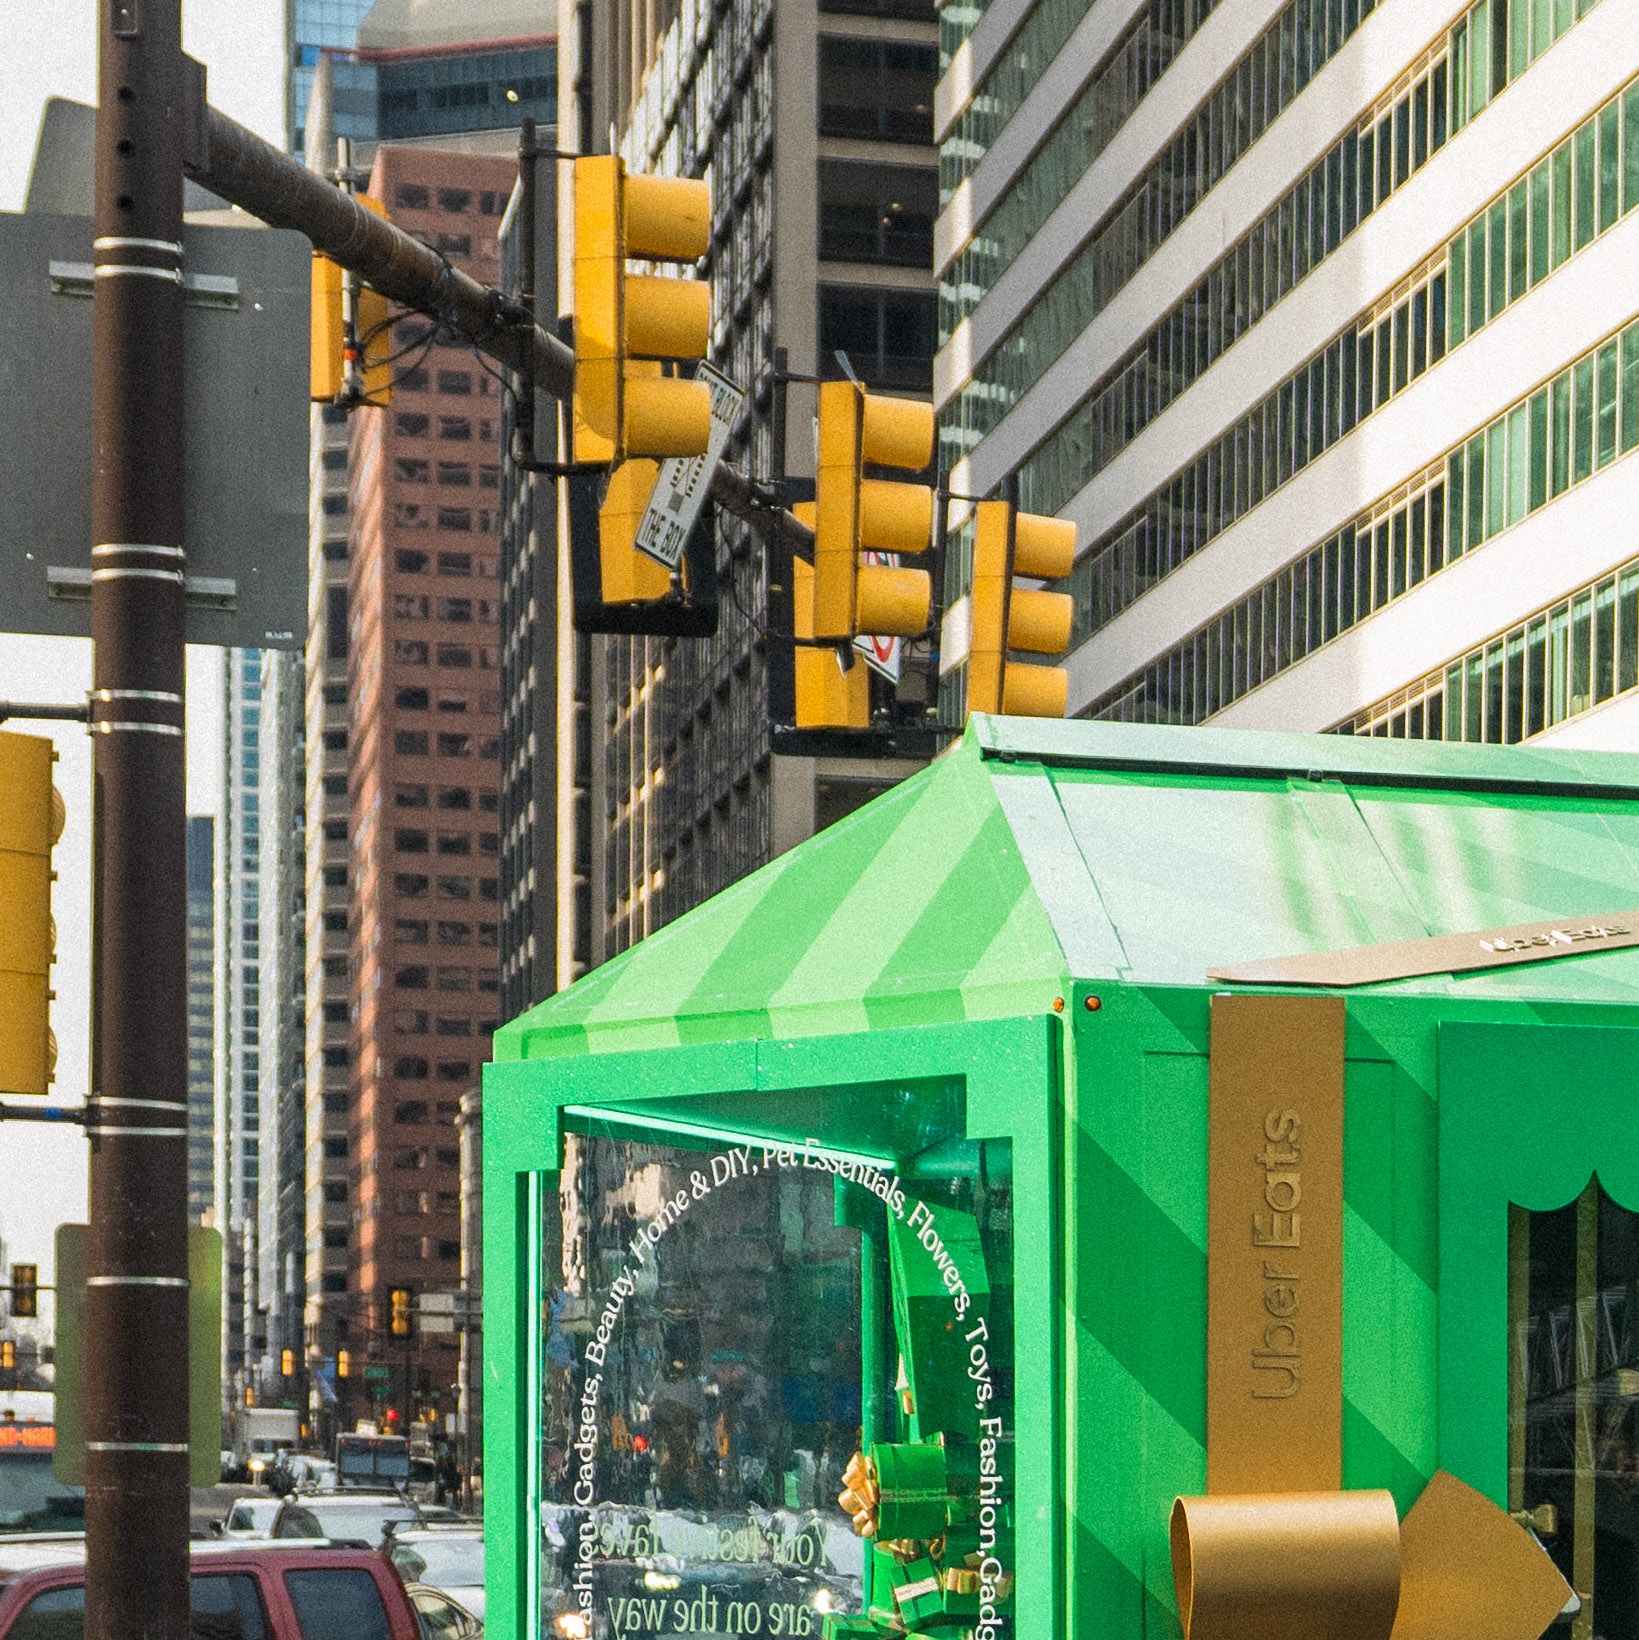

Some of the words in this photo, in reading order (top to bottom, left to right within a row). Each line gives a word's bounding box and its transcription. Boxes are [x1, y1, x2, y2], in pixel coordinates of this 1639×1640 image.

[641, 508, 666, 549] THE
[660, 519, 686, 561] BOX
[689, 1169, 712, 1201] &
[709, 1143, 759, 1188] DIY,
[762, 1144, 800, 1170] Pet
[802, 1137, 906, 1220] Essentials,
[1252, 1108, 1301, 1248] Eats
[629, 1188, 690, 1264] Home
[906, 1200, 972, 1322] Flowers,
[585, 1263, 640, 1367] Beauty,
[1252, 1260, 1301, 1400] Uber
[965, 1316, 993, 1411] Toys,
[573, 1370, 603, 1506] Gadgets,
[978, 1415, 1004, 1556] Fashion,
